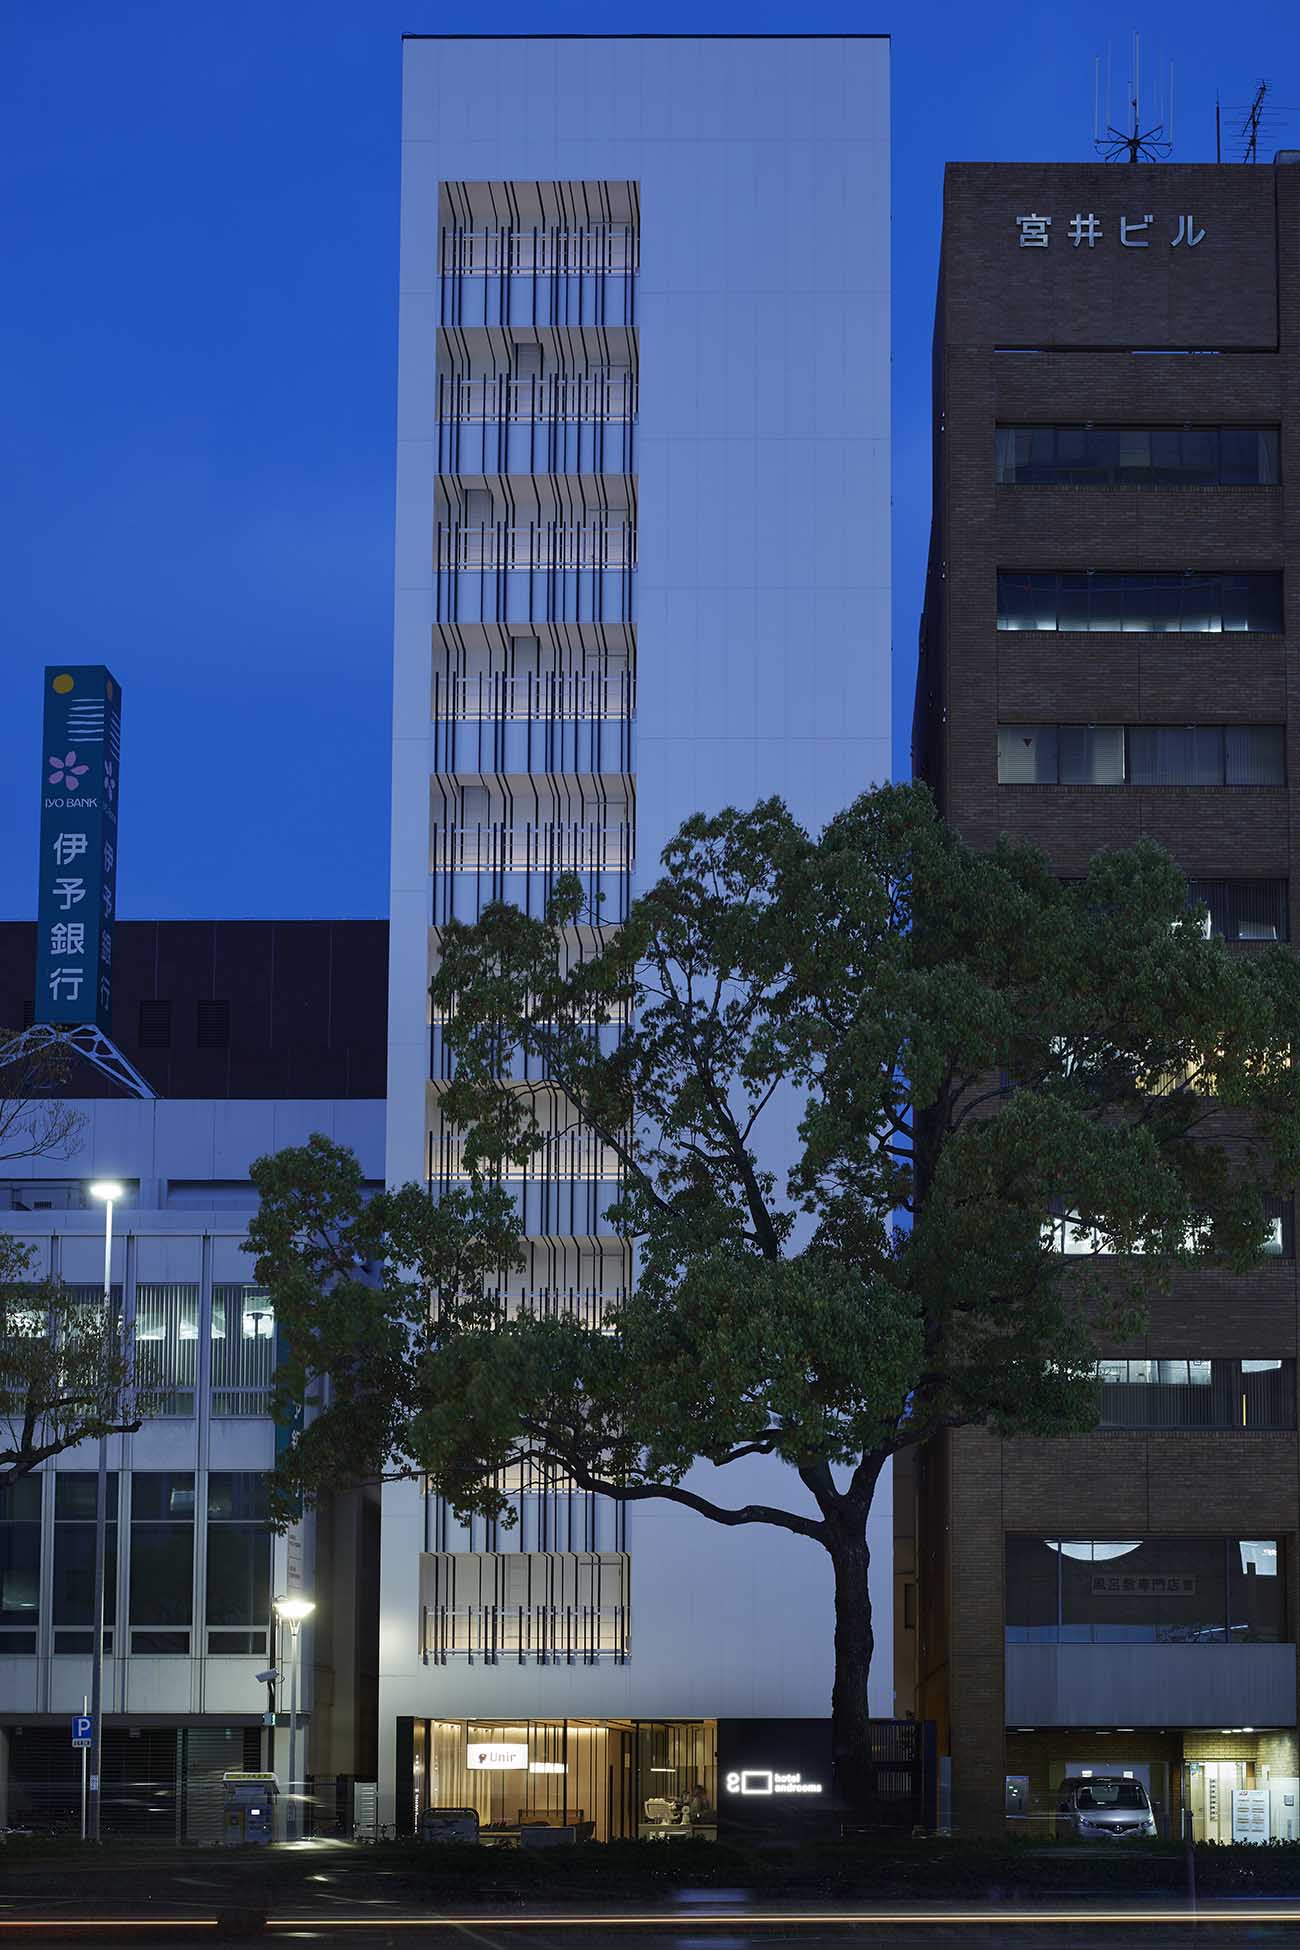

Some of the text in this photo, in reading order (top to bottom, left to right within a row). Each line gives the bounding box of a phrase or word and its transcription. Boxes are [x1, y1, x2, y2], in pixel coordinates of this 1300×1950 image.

[1016, 213, 1206, 248] 宮井ビル
[45, 798, 98, 808] IYO BANK
[48, 832, 89, 1001] 伊予銀行
[78, 1718, 91, 1737] P
[490, 1752, 517, 1762] Unir
[774, 1773, 801, 1783] hotel
[774, 1783, 822, 1793] androoms
